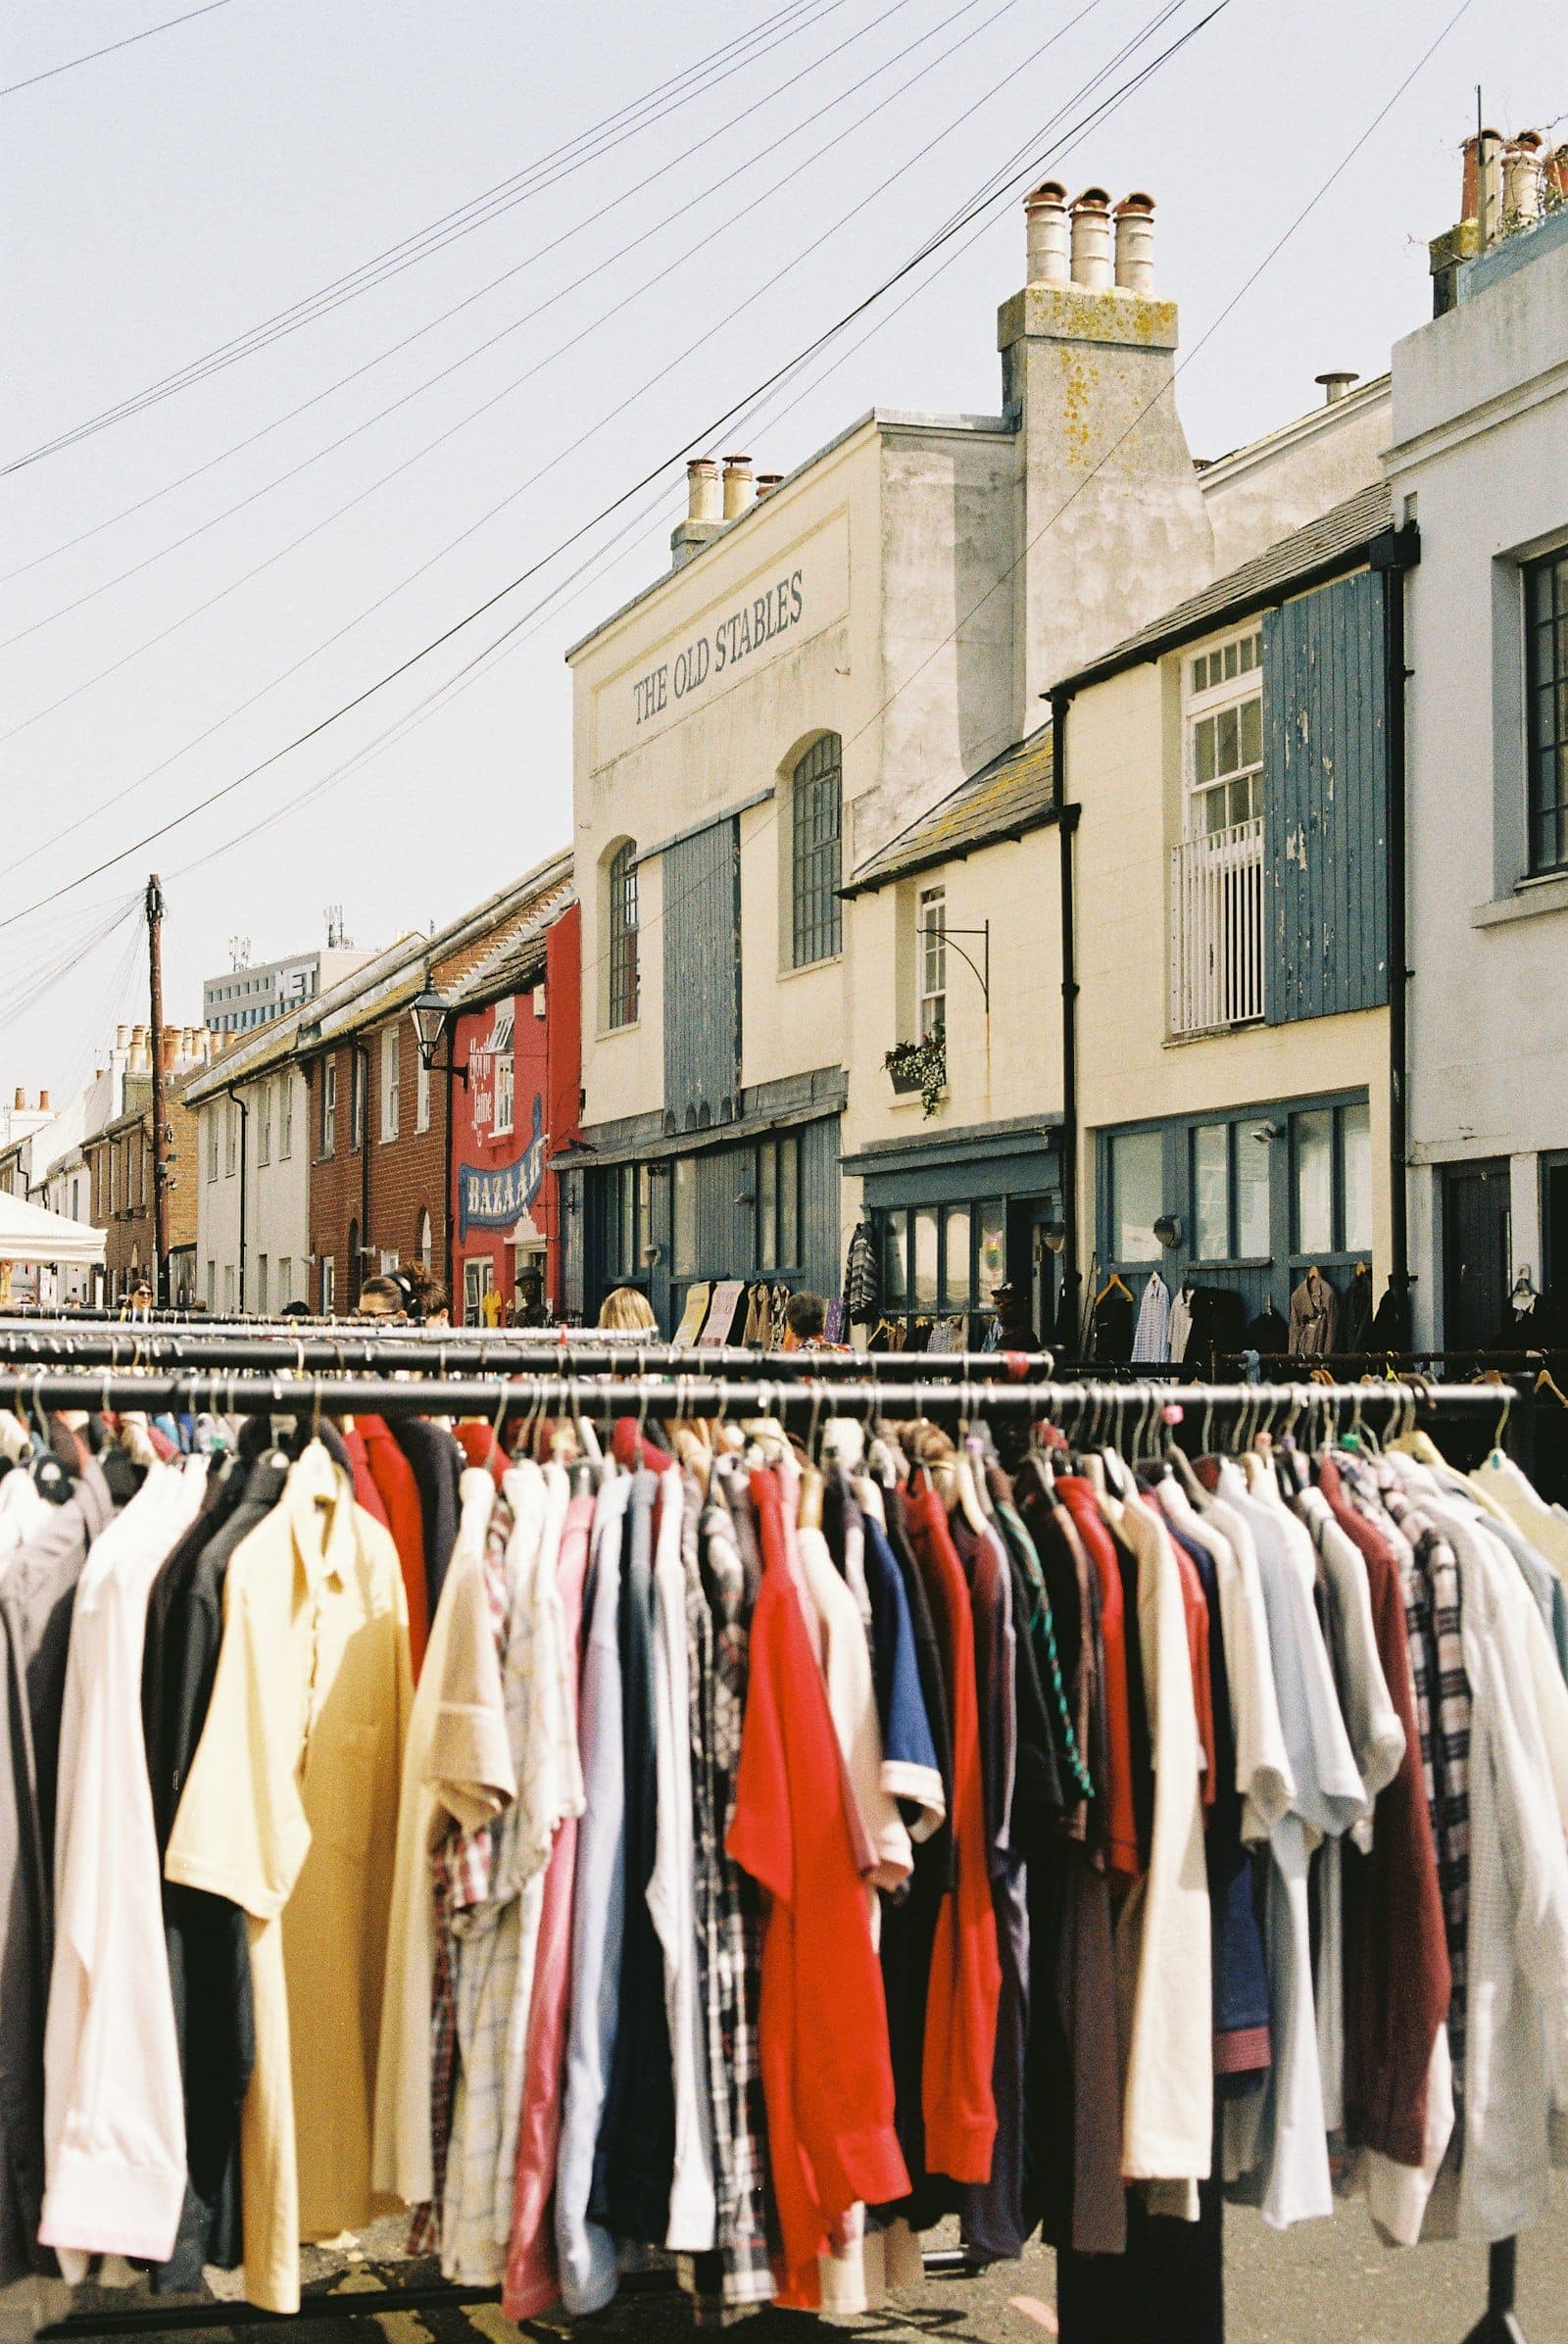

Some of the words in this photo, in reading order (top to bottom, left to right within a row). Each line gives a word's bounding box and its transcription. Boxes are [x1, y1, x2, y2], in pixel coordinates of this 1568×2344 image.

[633, 663, 668, 724] THE
[674, 638, 710, 699] OLD
[715, 568, 803, 672] STABLES
[275, 961, 317, 1001] MET
[468, 1146, 541, 1216] BAZAAR
